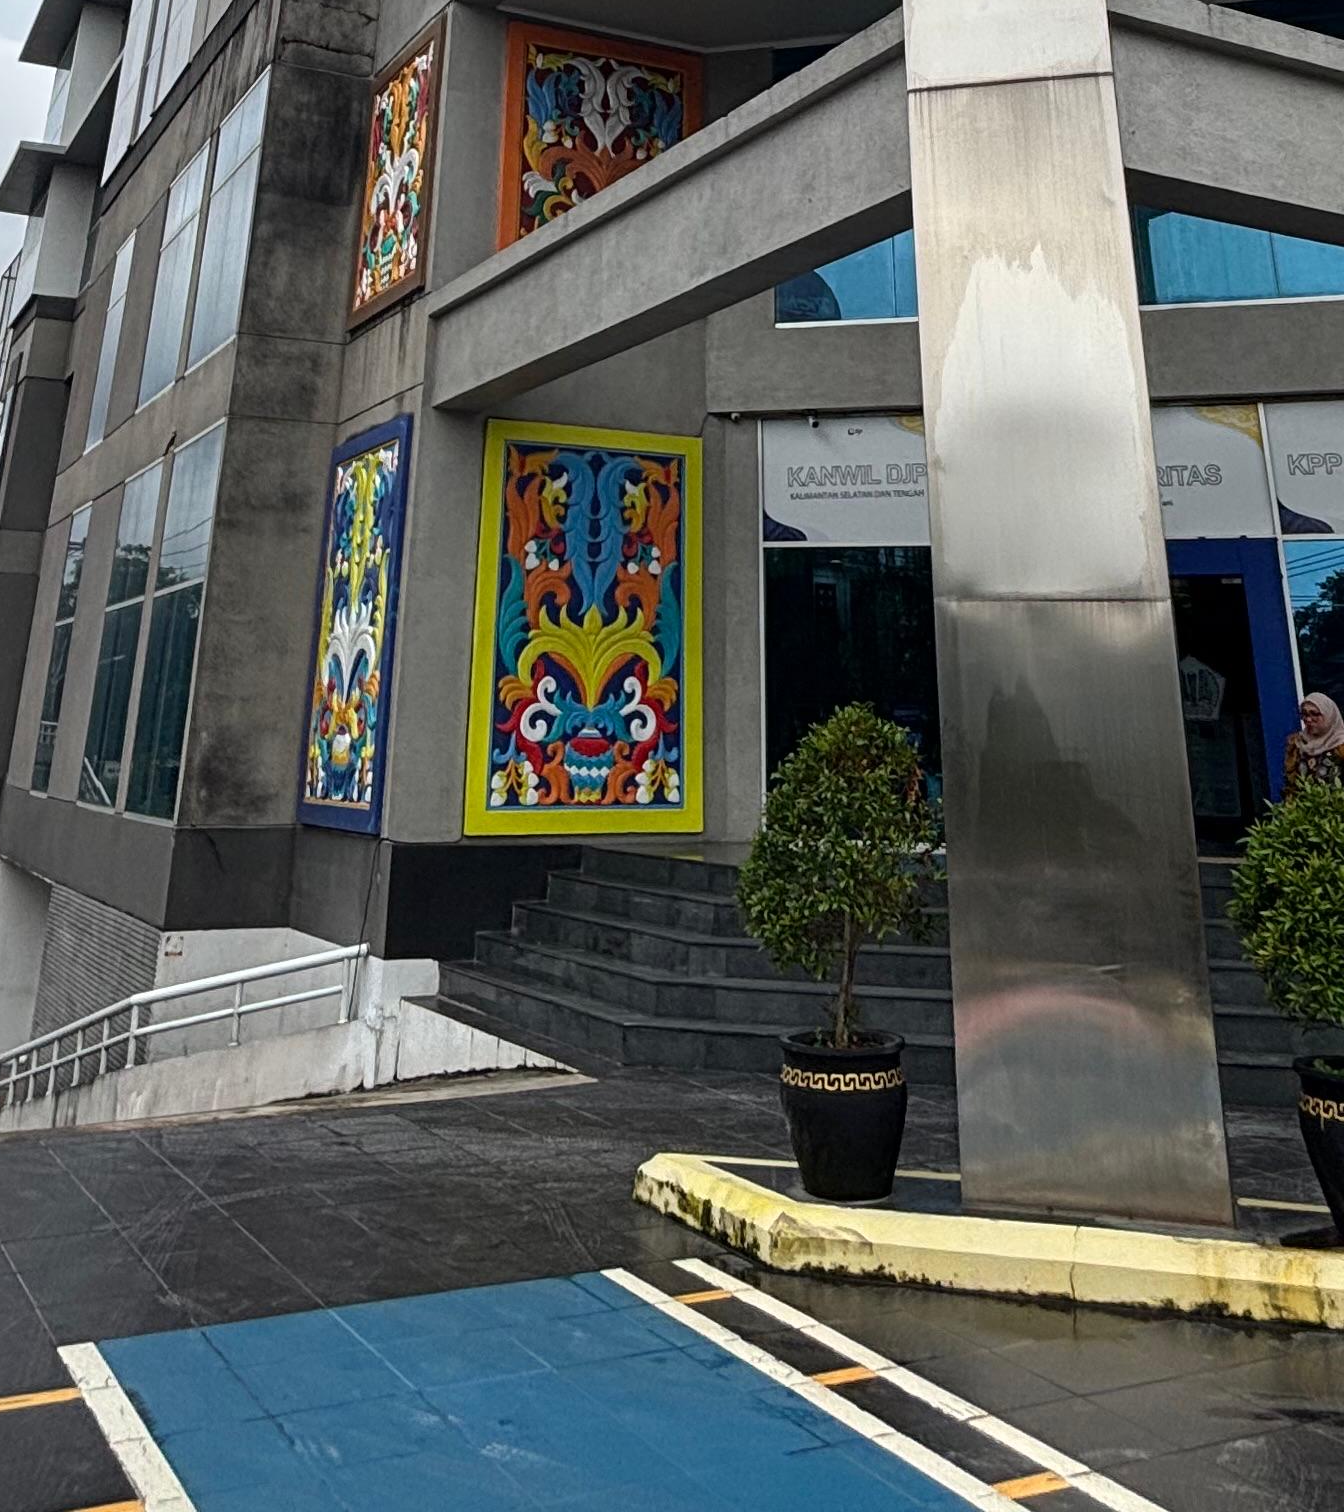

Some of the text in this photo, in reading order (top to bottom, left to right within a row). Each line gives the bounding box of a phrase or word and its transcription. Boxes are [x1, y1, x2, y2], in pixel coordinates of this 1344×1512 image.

[787, 463, 928, 487] KANWIL DJP
[1157, 464, 1223, 487] RITAS
[1287, 452, 1343, 476] KPP
